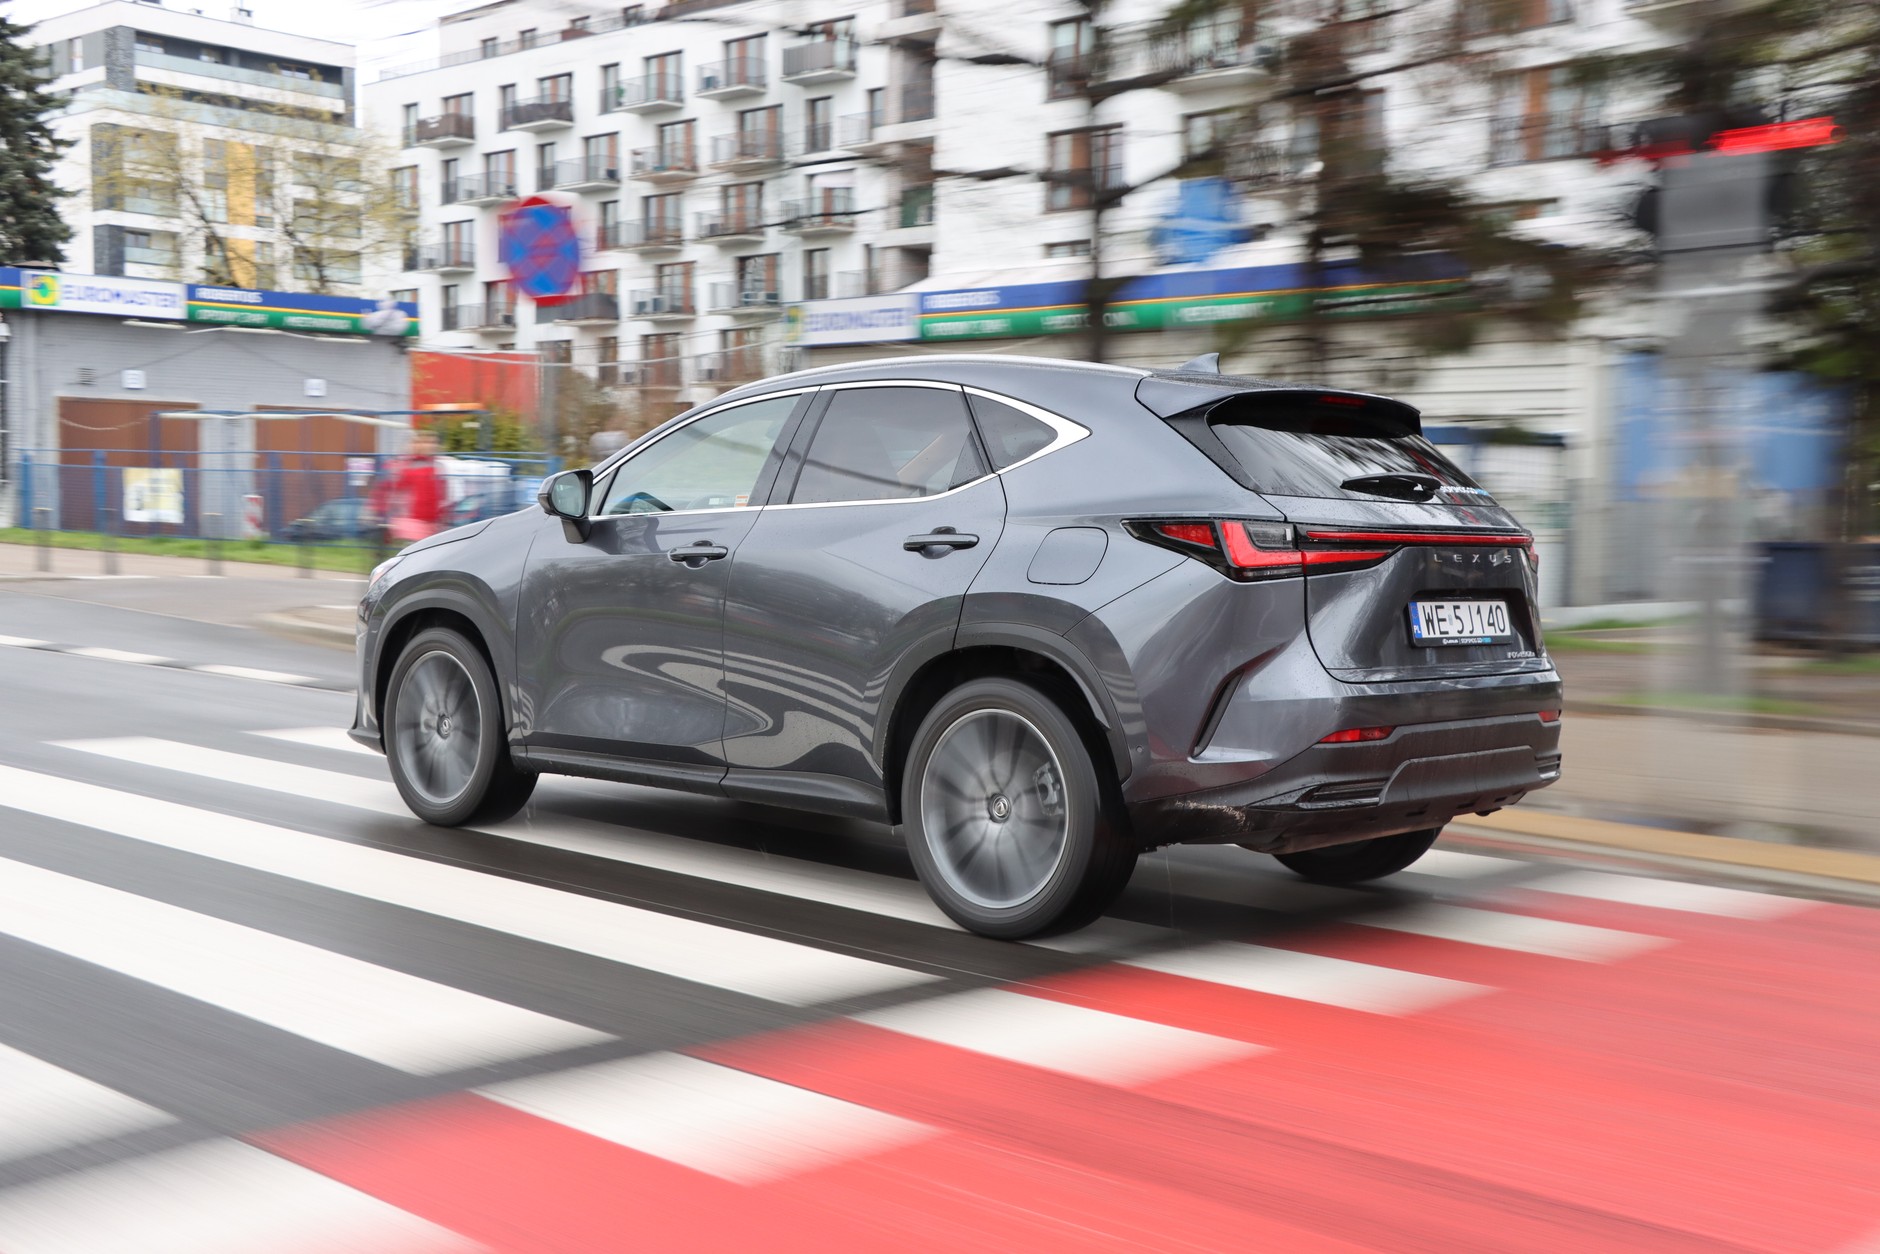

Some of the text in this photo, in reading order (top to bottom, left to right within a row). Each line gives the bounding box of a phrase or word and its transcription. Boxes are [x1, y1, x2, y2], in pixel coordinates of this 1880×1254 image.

[62, 284, 180, 308] EUROMASTER
[1433, 553, 1512, 564] LEXUS
[1422, 604, 1506, 635] WE 5J140
[1413, 625, 1421, 634] PL
